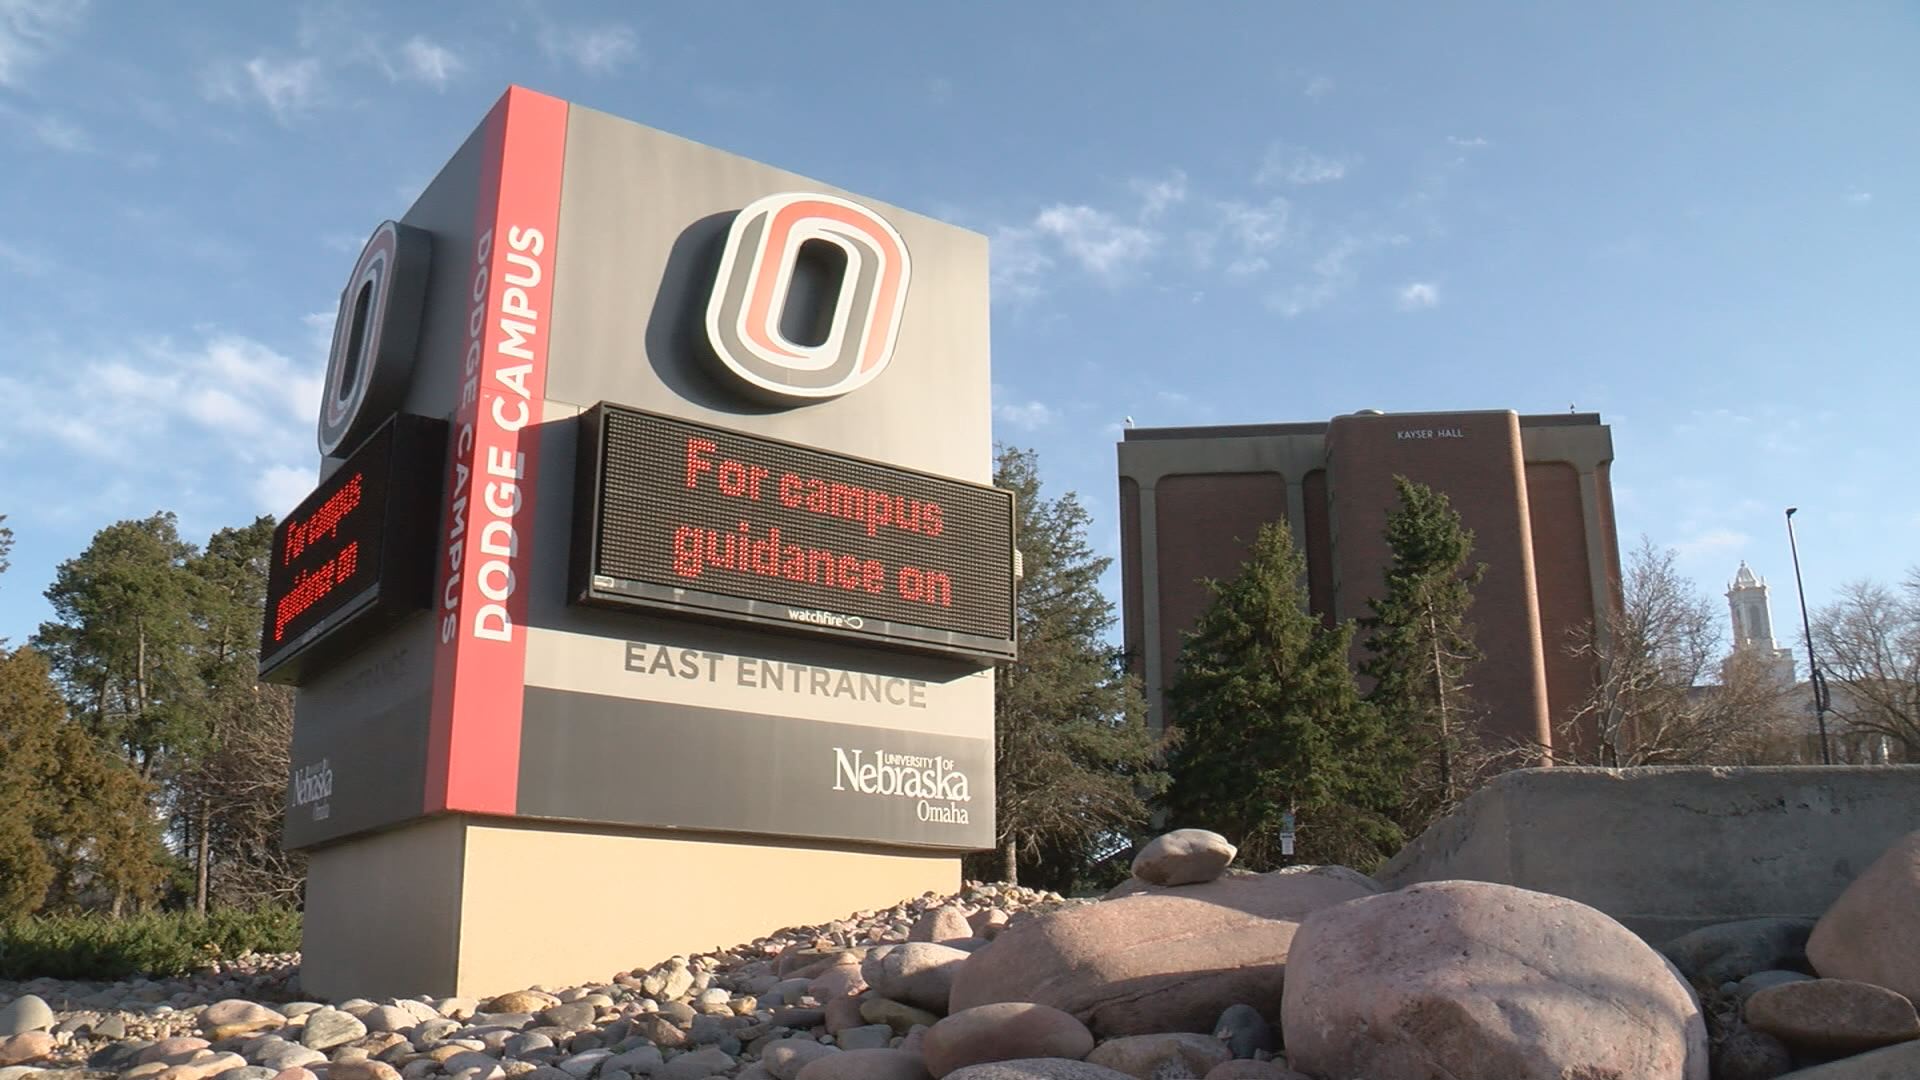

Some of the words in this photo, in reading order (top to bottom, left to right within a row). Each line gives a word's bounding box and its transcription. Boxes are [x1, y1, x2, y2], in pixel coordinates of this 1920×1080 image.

[463, 228, 493, 410] DODGE
[491, 225, 545, 432] CAMPUS
[1397, 429, 1434, 440] KAYSER
[1437, 427, 1465, 438] HALL
[685, 436, 769, 501] For
[778, 470, 945, 538] campus
[441, 422, 473, 644] CAMPUS
[473, 446, 526, 643] DODGE
[672, 520, 885, 595] guidance
[897, 565, 952, 608] on
[624, 640, 724, 682] EAST
[737, 656, 927, 709] ENTRANCE
[832, 747, 971, 802] Nebraska
[884, 753, 935, 769] UNIVERSITY
[942, 760, 955, 771] OF
[917, 799, 969, 825] Omaha
